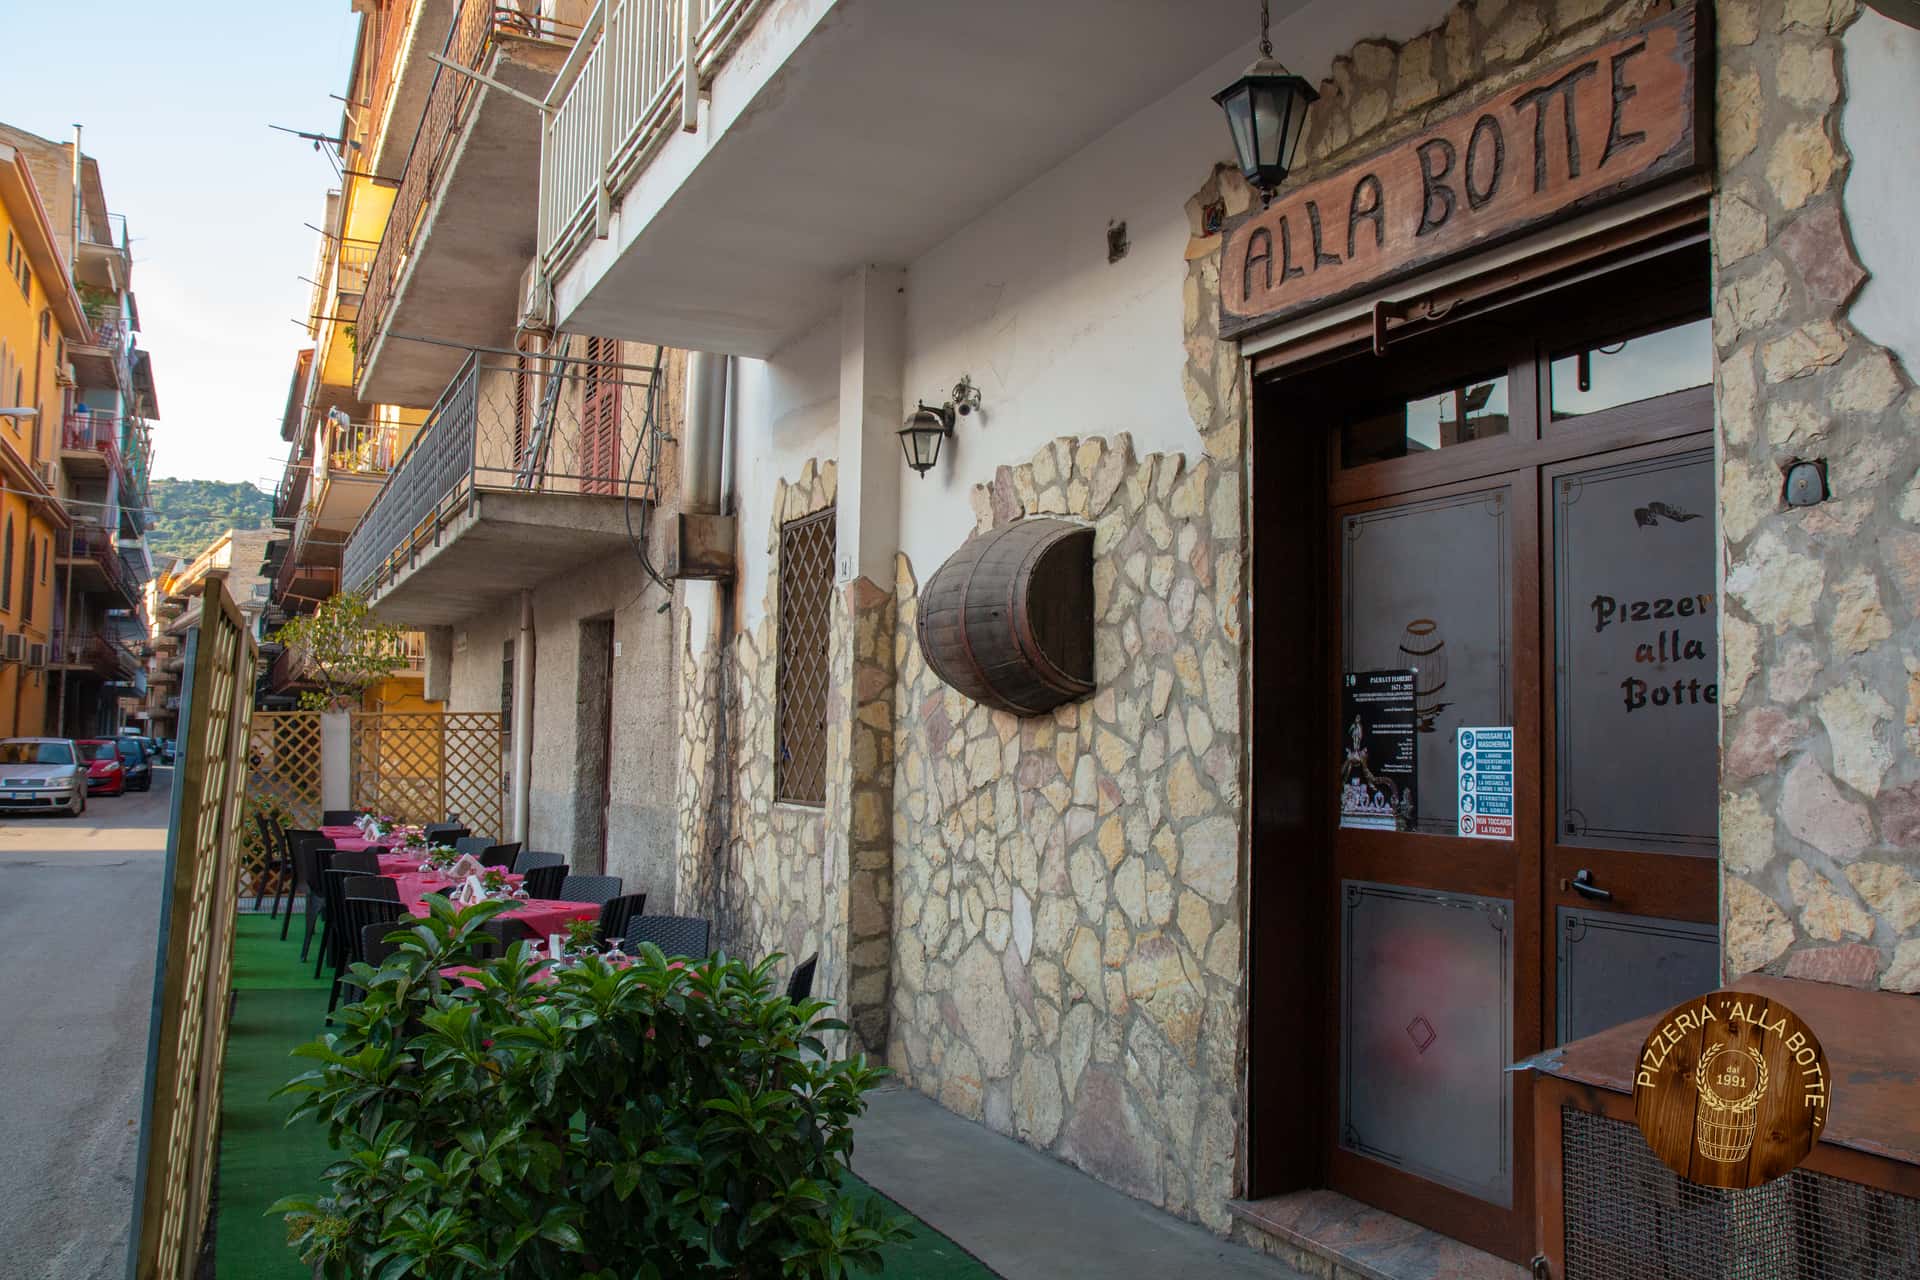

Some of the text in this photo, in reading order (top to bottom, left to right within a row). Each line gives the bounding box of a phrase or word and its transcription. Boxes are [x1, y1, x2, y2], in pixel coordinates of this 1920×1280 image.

[1242, 41, 1647, 302] ALLA BOTTE
[1634, 629, 1706, 664] alla
[1621, 676, 1718, 713] Botte
